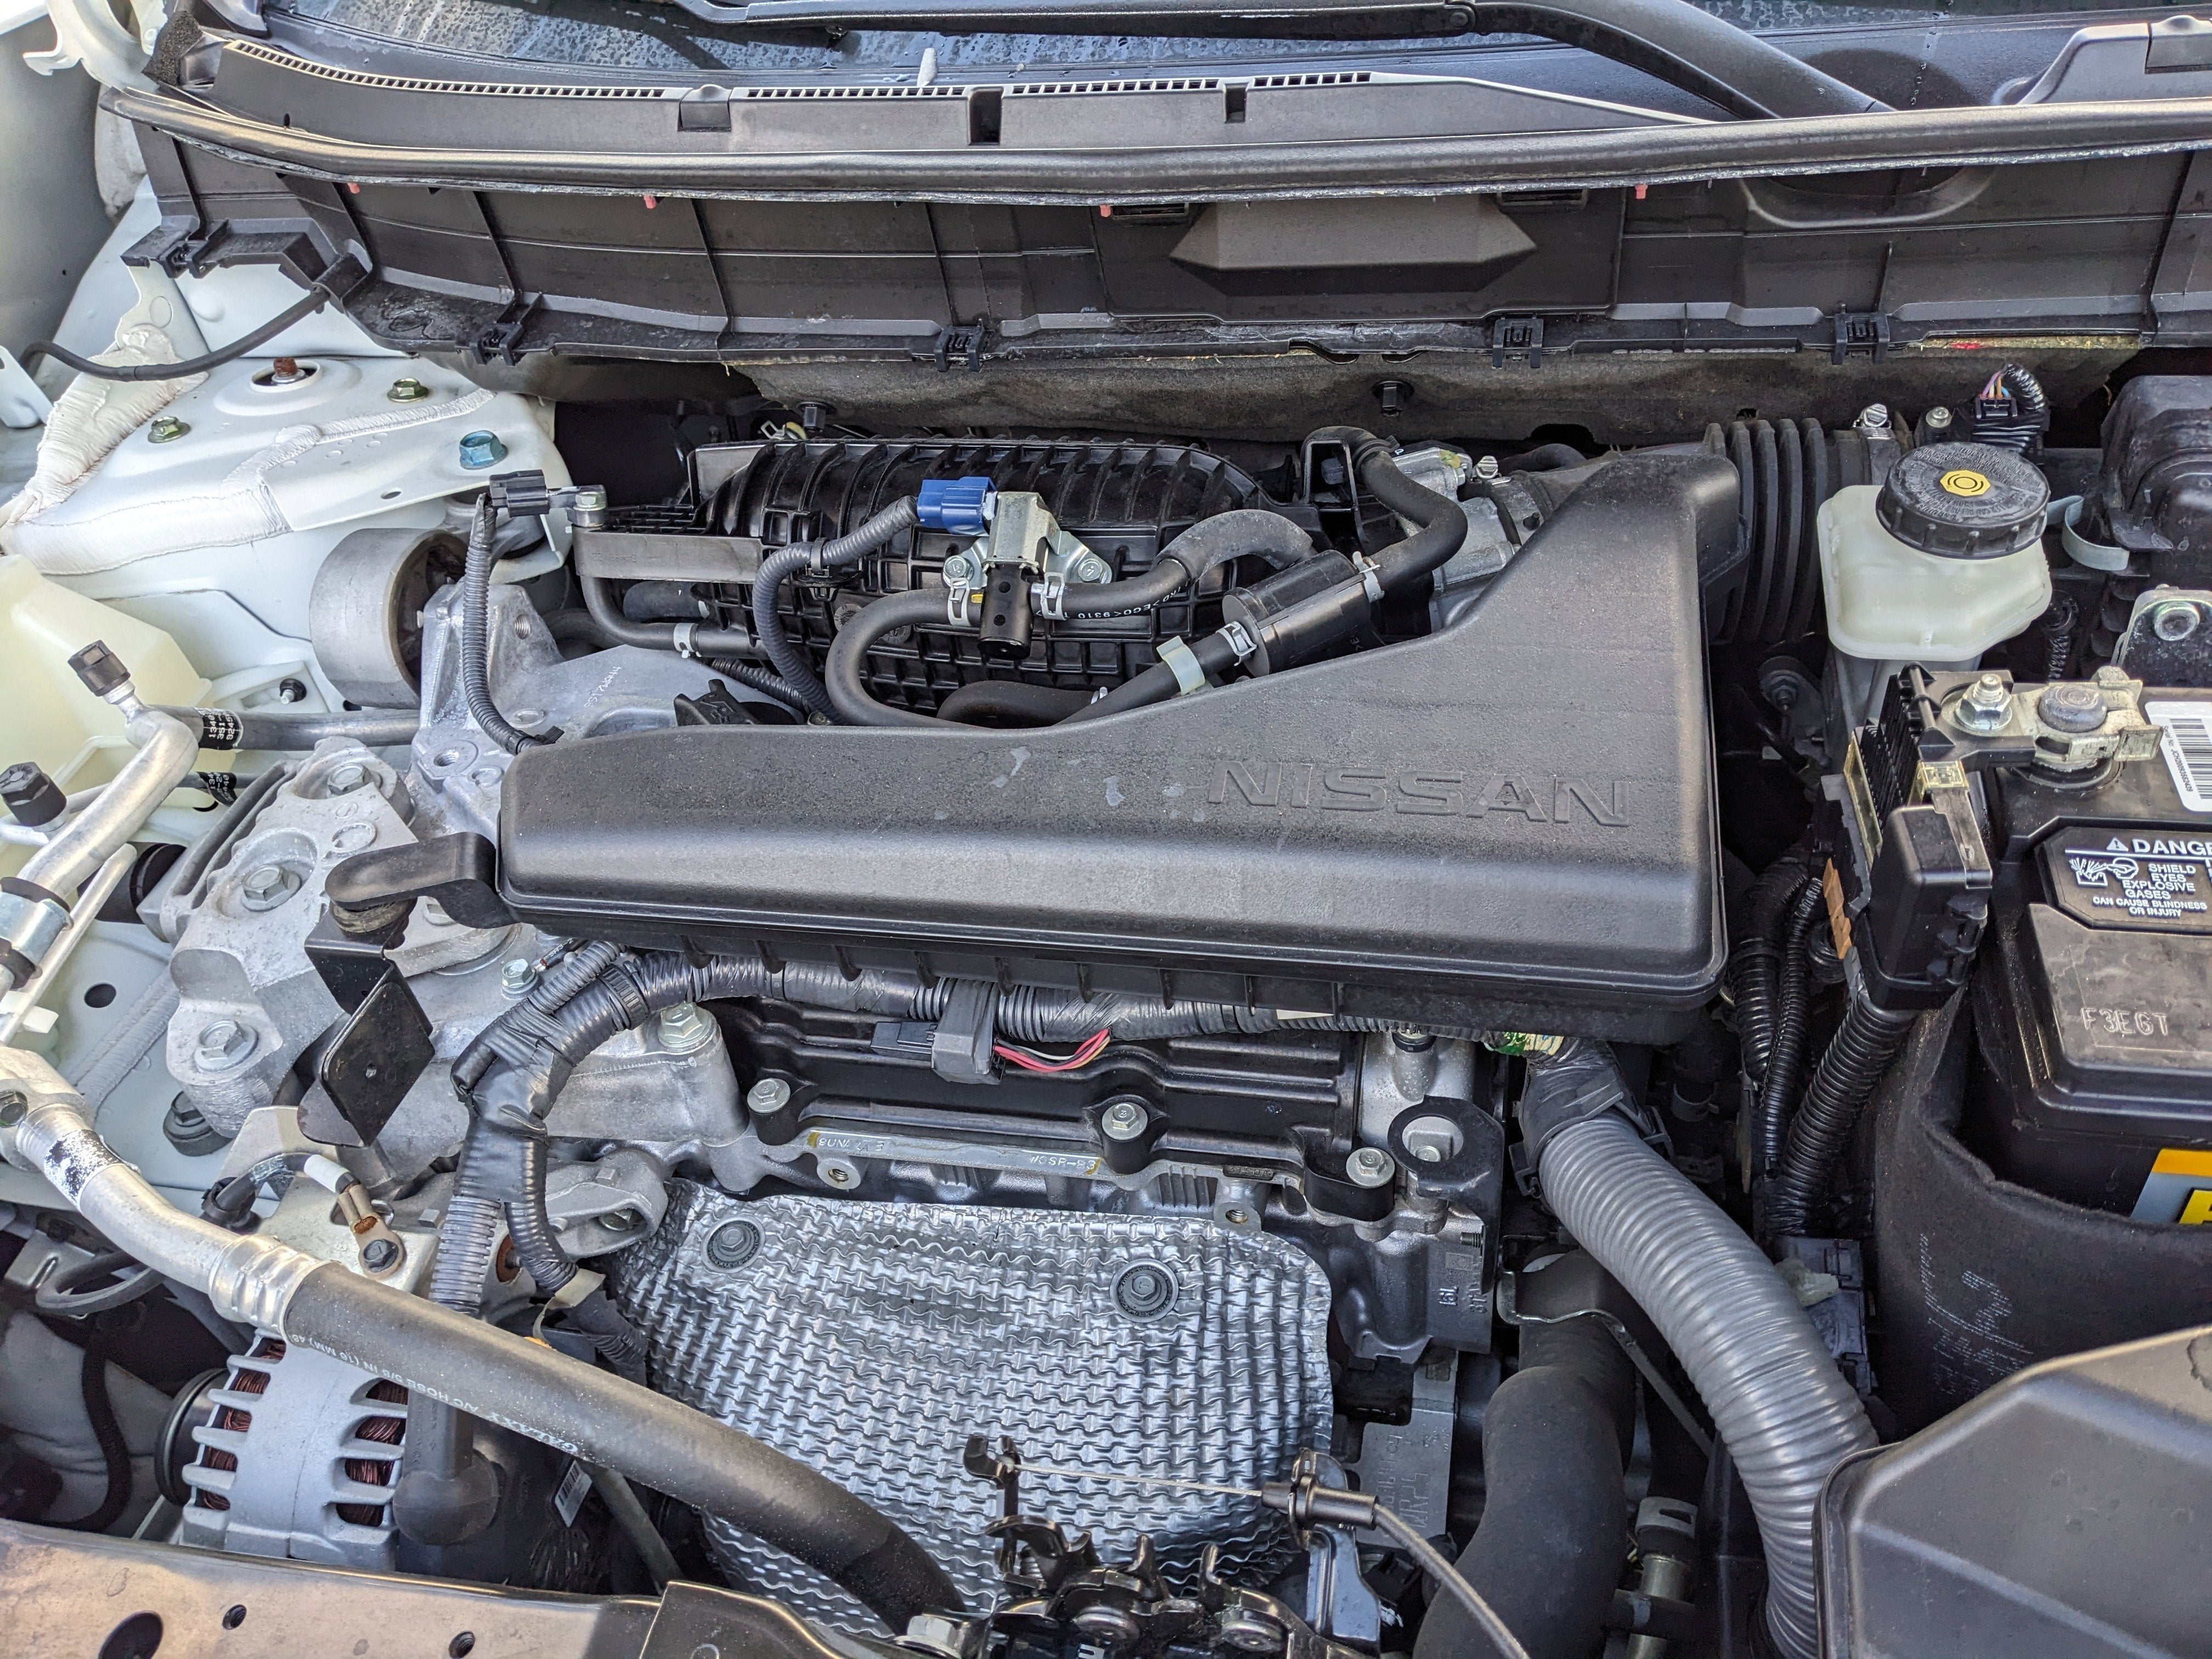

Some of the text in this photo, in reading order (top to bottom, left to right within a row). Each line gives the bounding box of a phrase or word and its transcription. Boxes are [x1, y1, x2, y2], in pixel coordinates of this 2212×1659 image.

[1208, 760, 1630, 827] NISSAN
[2148, 863, 2197, 875] SHIELD
[2151, 873, 2187, 883] EYES
[2122, 879, 2197, 893] EXPLOSIVE
[2124, 889, 2171, 900] GASES
[2092, 896, 2208, 911] CAN CAUSE BLINDNESS
[2129, 906, 2182, 918] OR INJURY
[363, 1361, 379, 1373] IN
[407, 1378, 448, 1402] HOSE
[453, 1398, 478, 1413] A/C
[487, 1412, 578, 1452] GALAXY
